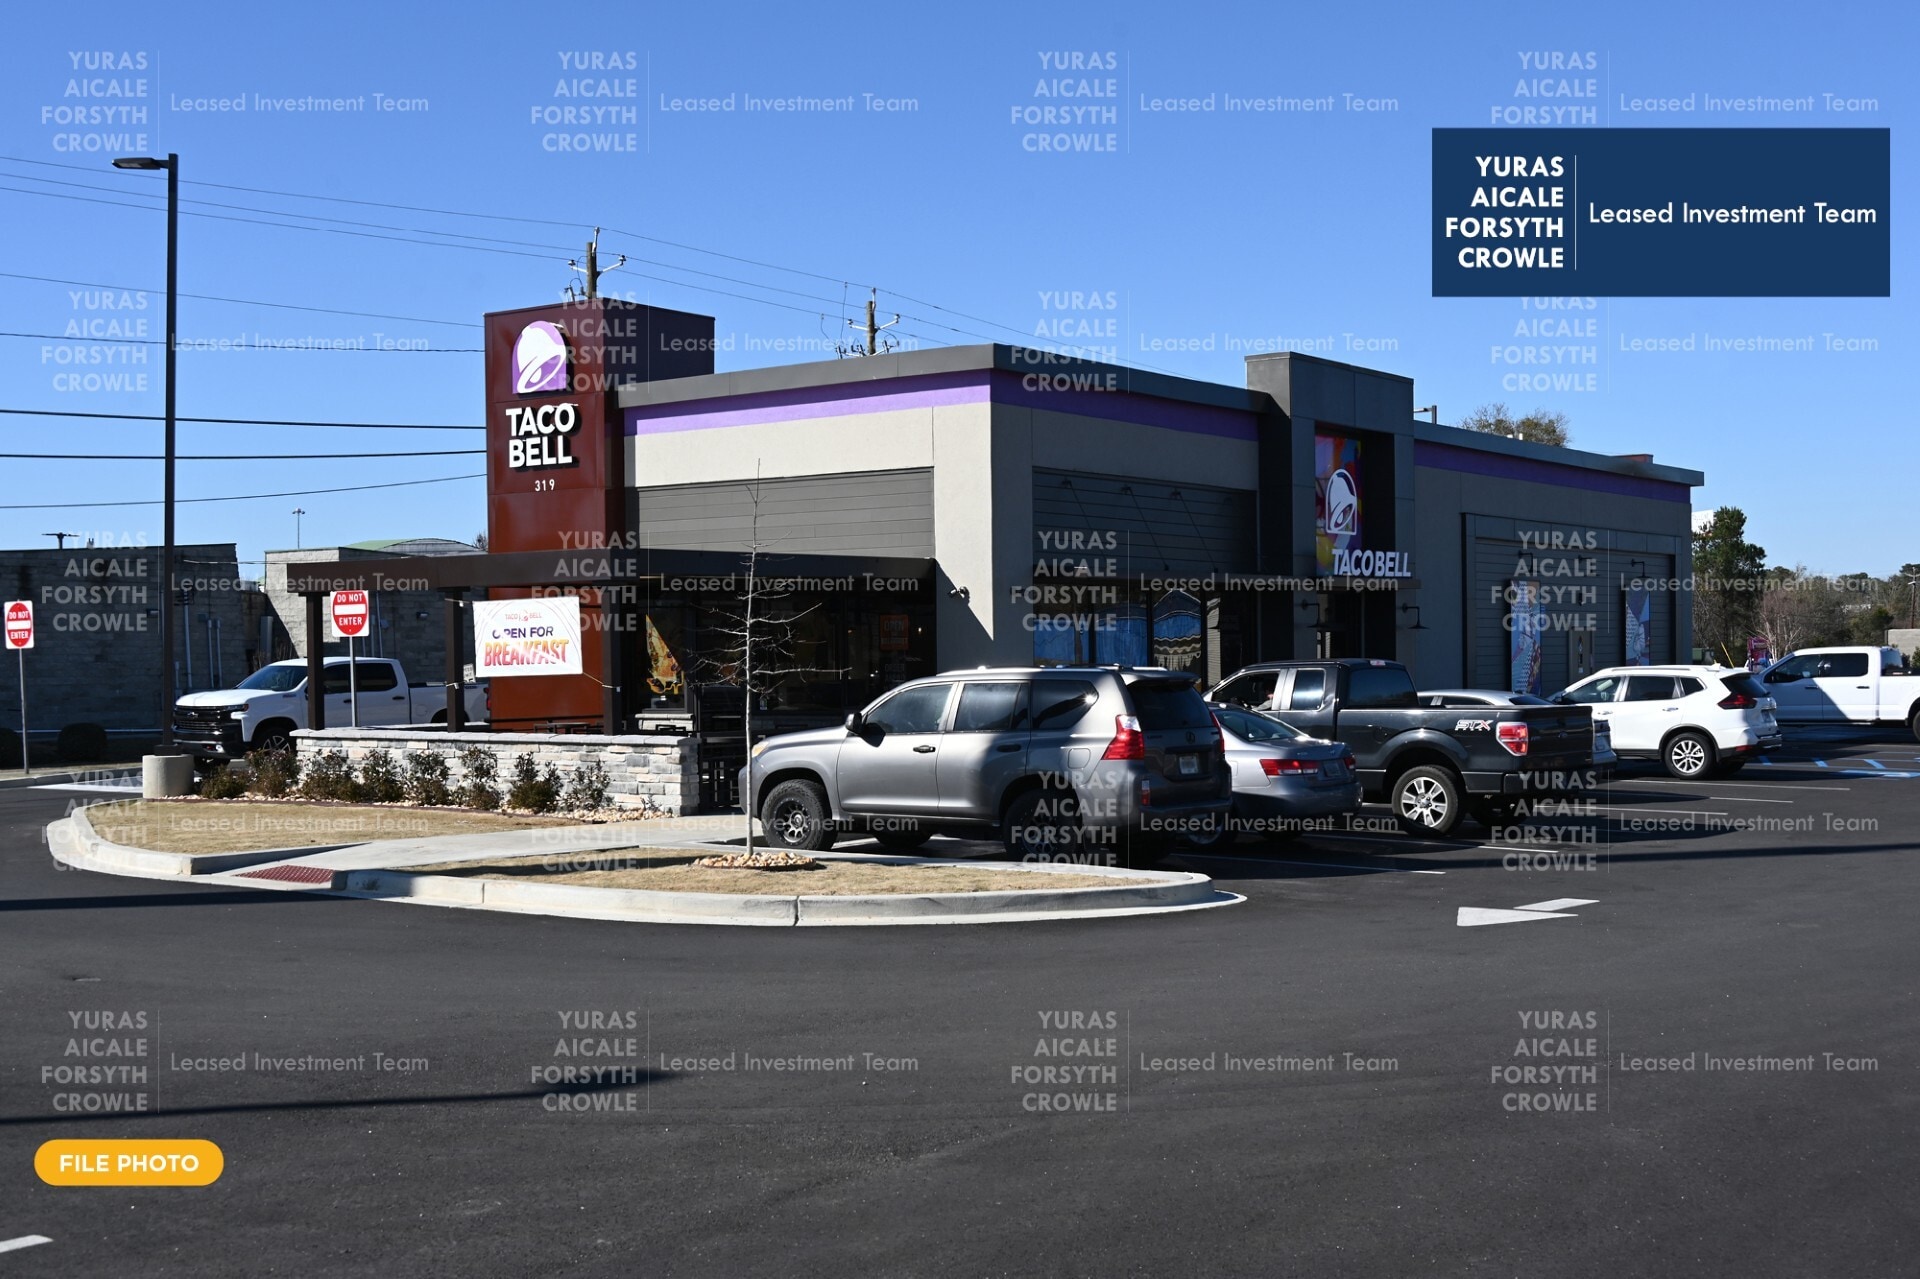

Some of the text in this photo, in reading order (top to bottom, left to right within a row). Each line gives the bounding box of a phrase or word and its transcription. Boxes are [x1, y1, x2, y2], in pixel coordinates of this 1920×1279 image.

[506, 403, 576, 436] TACO
[509, 435, 572, 468] BELL
[535, 479, 555, 492] 319
[337, 593, 363, 603] DO NOT
[18, 611, 29, 619] NOT
[339, 617, 362, 626] ENTER
[10, 631, 29, 640] ENTER
[530, 626, 554, 638] FOR
[484, 639, 569, 667] BREAKFAST
[1455, 719, 1494, 731] STX
